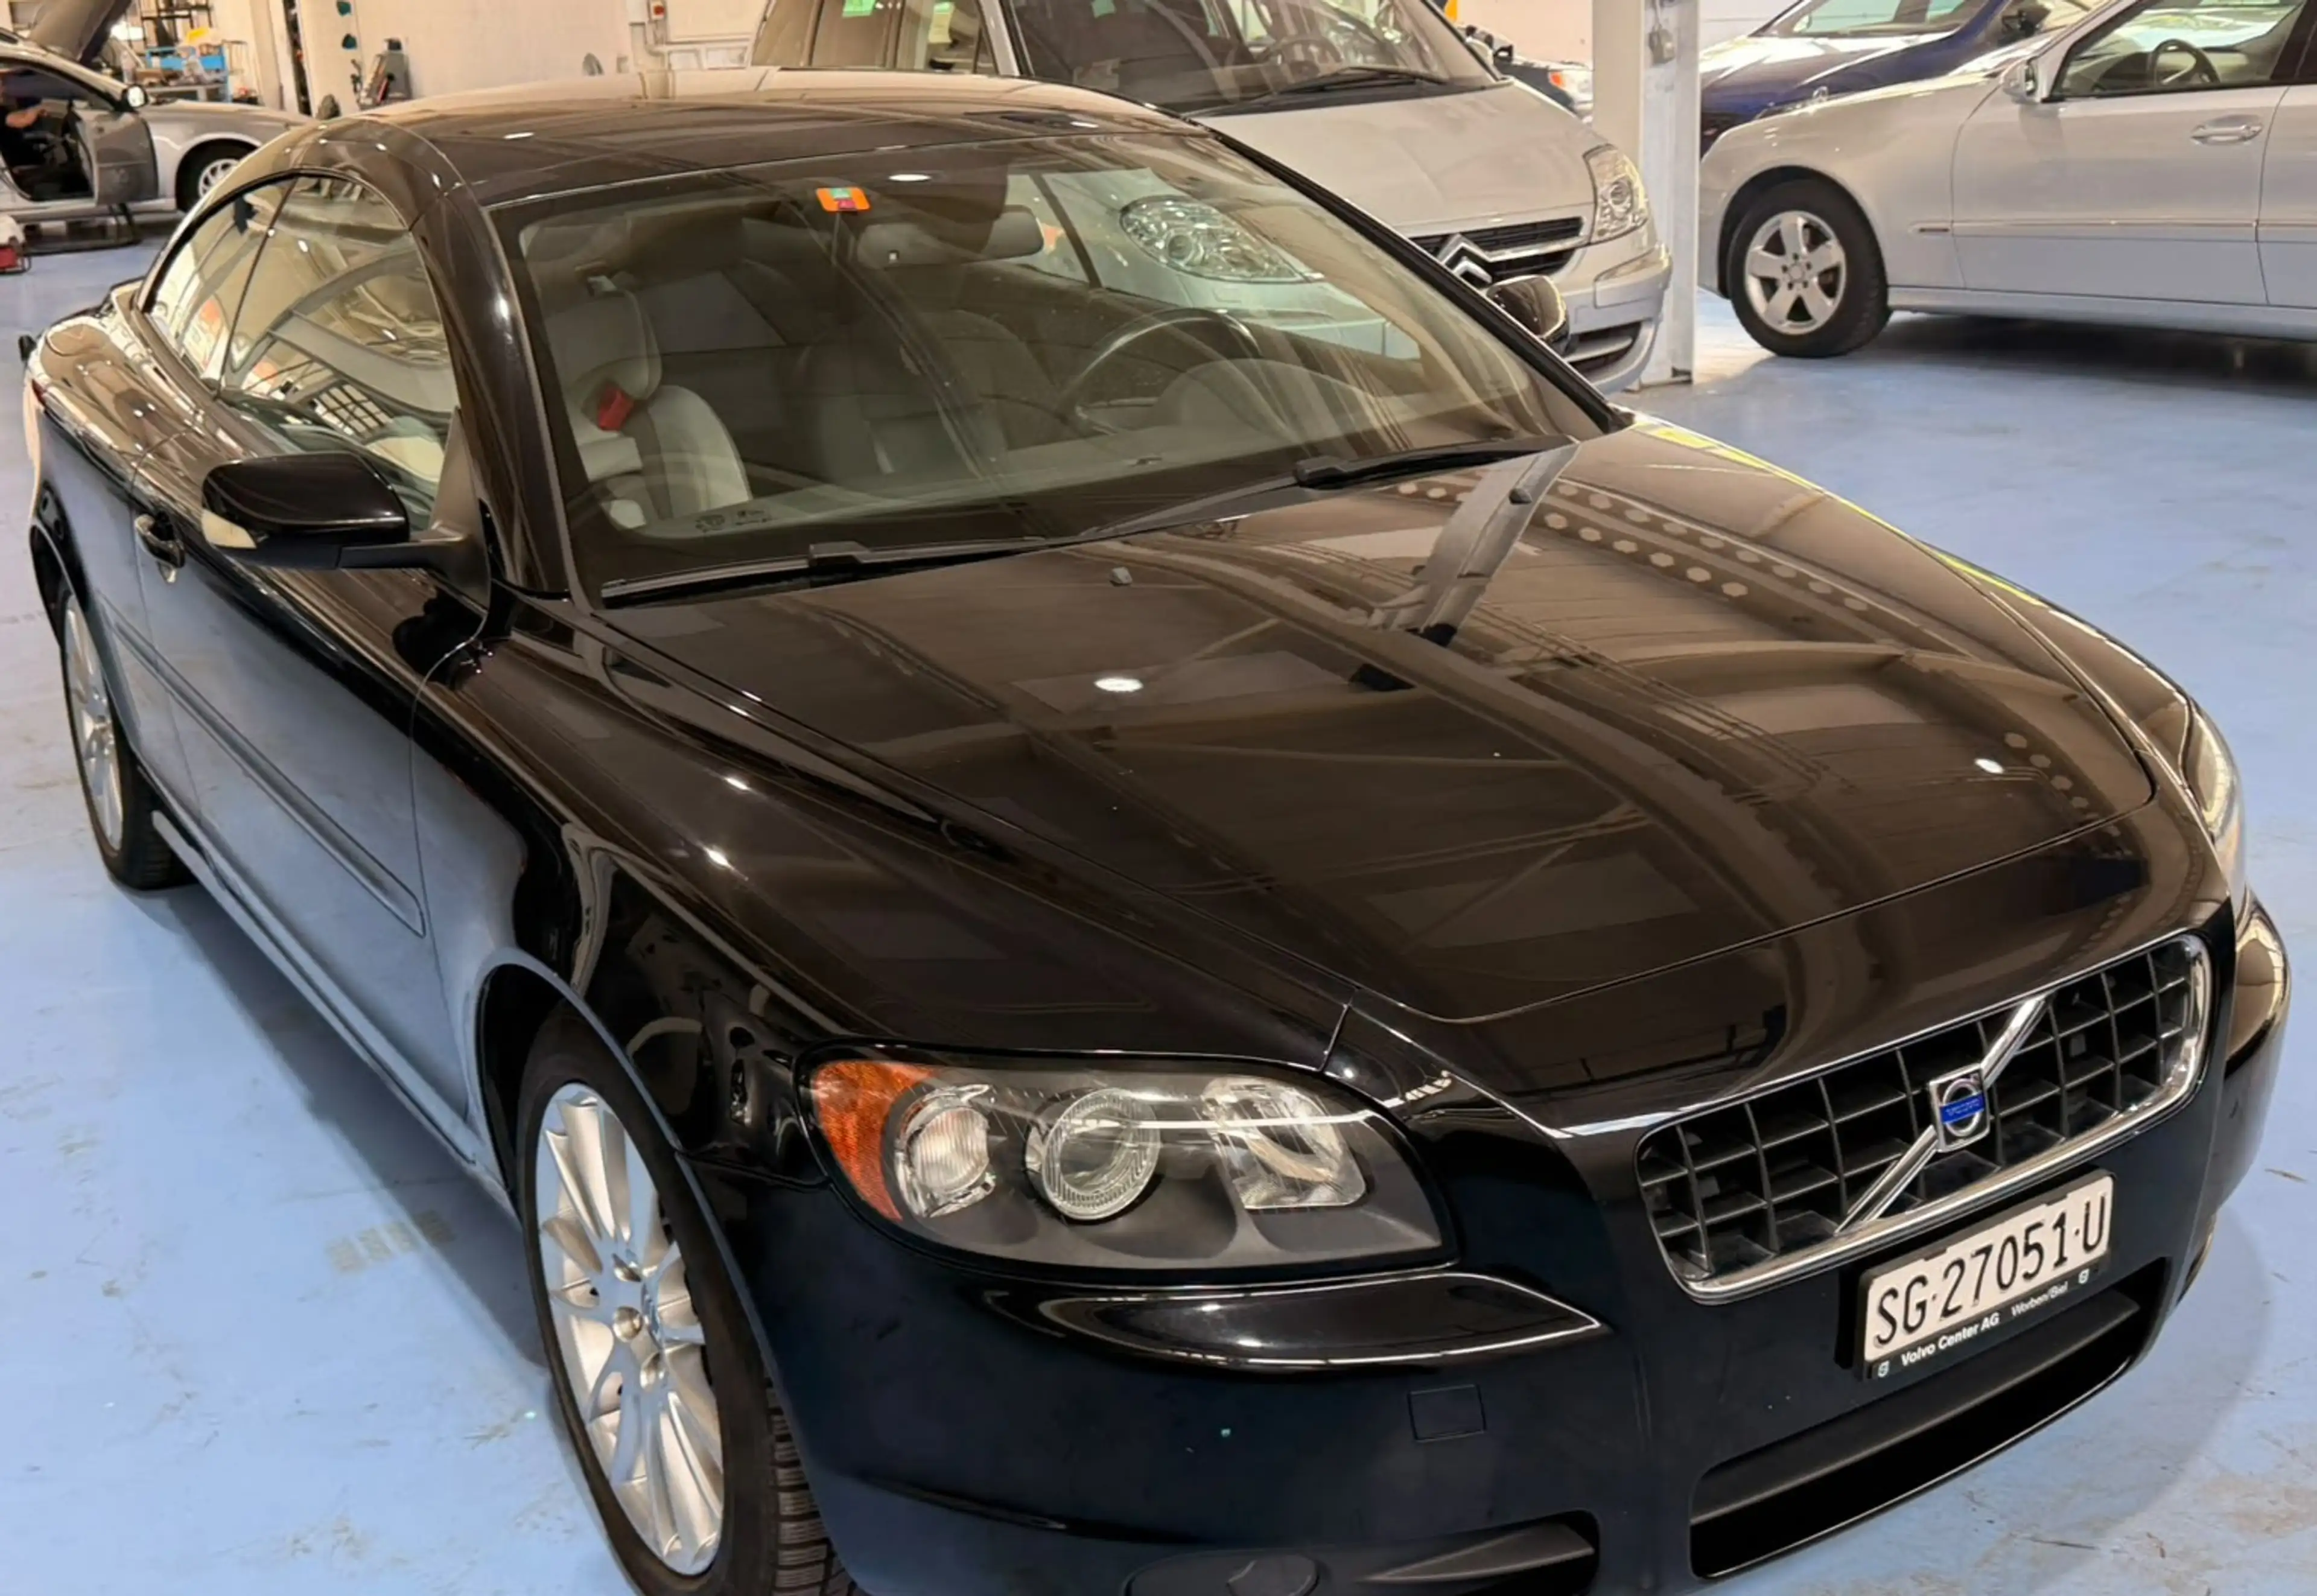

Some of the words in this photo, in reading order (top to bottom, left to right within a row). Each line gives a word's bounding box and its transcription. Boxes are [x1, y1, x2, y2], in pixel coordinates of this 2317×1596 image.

[1901, 1343, 1936, 1366] Volvo
[1938, 1323, 1979, 1350] Center
[1981, 1312, 2000, 1331] AG
